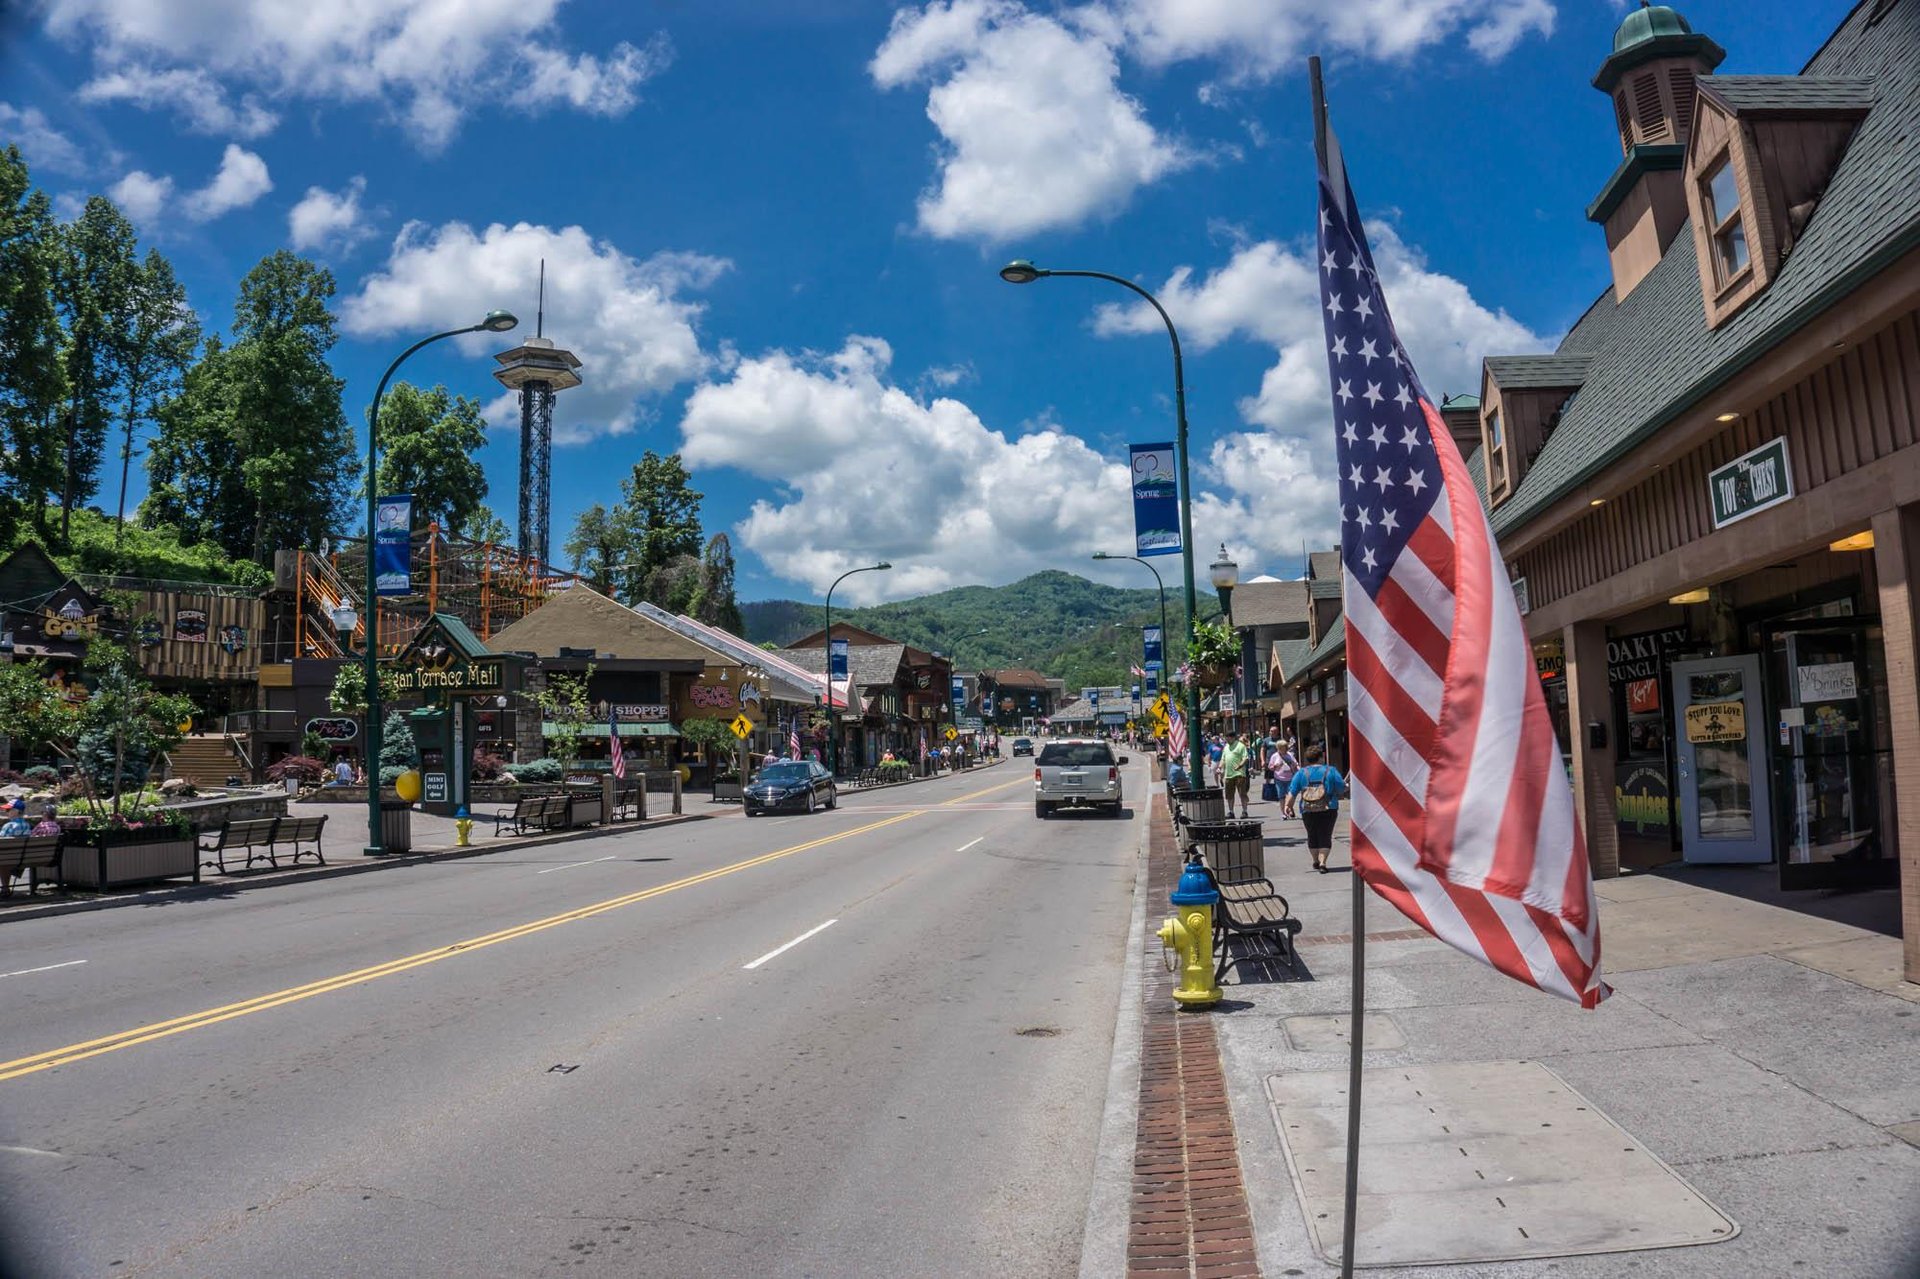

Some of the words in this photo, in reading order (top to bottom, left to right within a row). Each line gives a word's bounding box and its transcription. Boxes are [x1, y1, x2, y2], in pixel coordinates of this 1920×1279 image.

[1737, 460, 1750, 473] The
[1719, 477, 1737, 515] TOY
[1750, 457, 1777, 502] CHEST
[177, 610, 206, 622] ESCAPE
[1536, 655, 1565, 671] EMO
[393, 672, 413, 692] gan
[415, 666, 464, 688] Terrace
[467, 664, 498, 685] Mall
[1800, 666, 1817, 684] No
[1813, 677, 1854, 691] Drinks
[615, 706, 668, 715] SHOPPE
[1688, 708, 1708, 721] STUFF
[1709, 705, 1722, 715] YOU
[1723, 705, 1741, 717] LOVE
